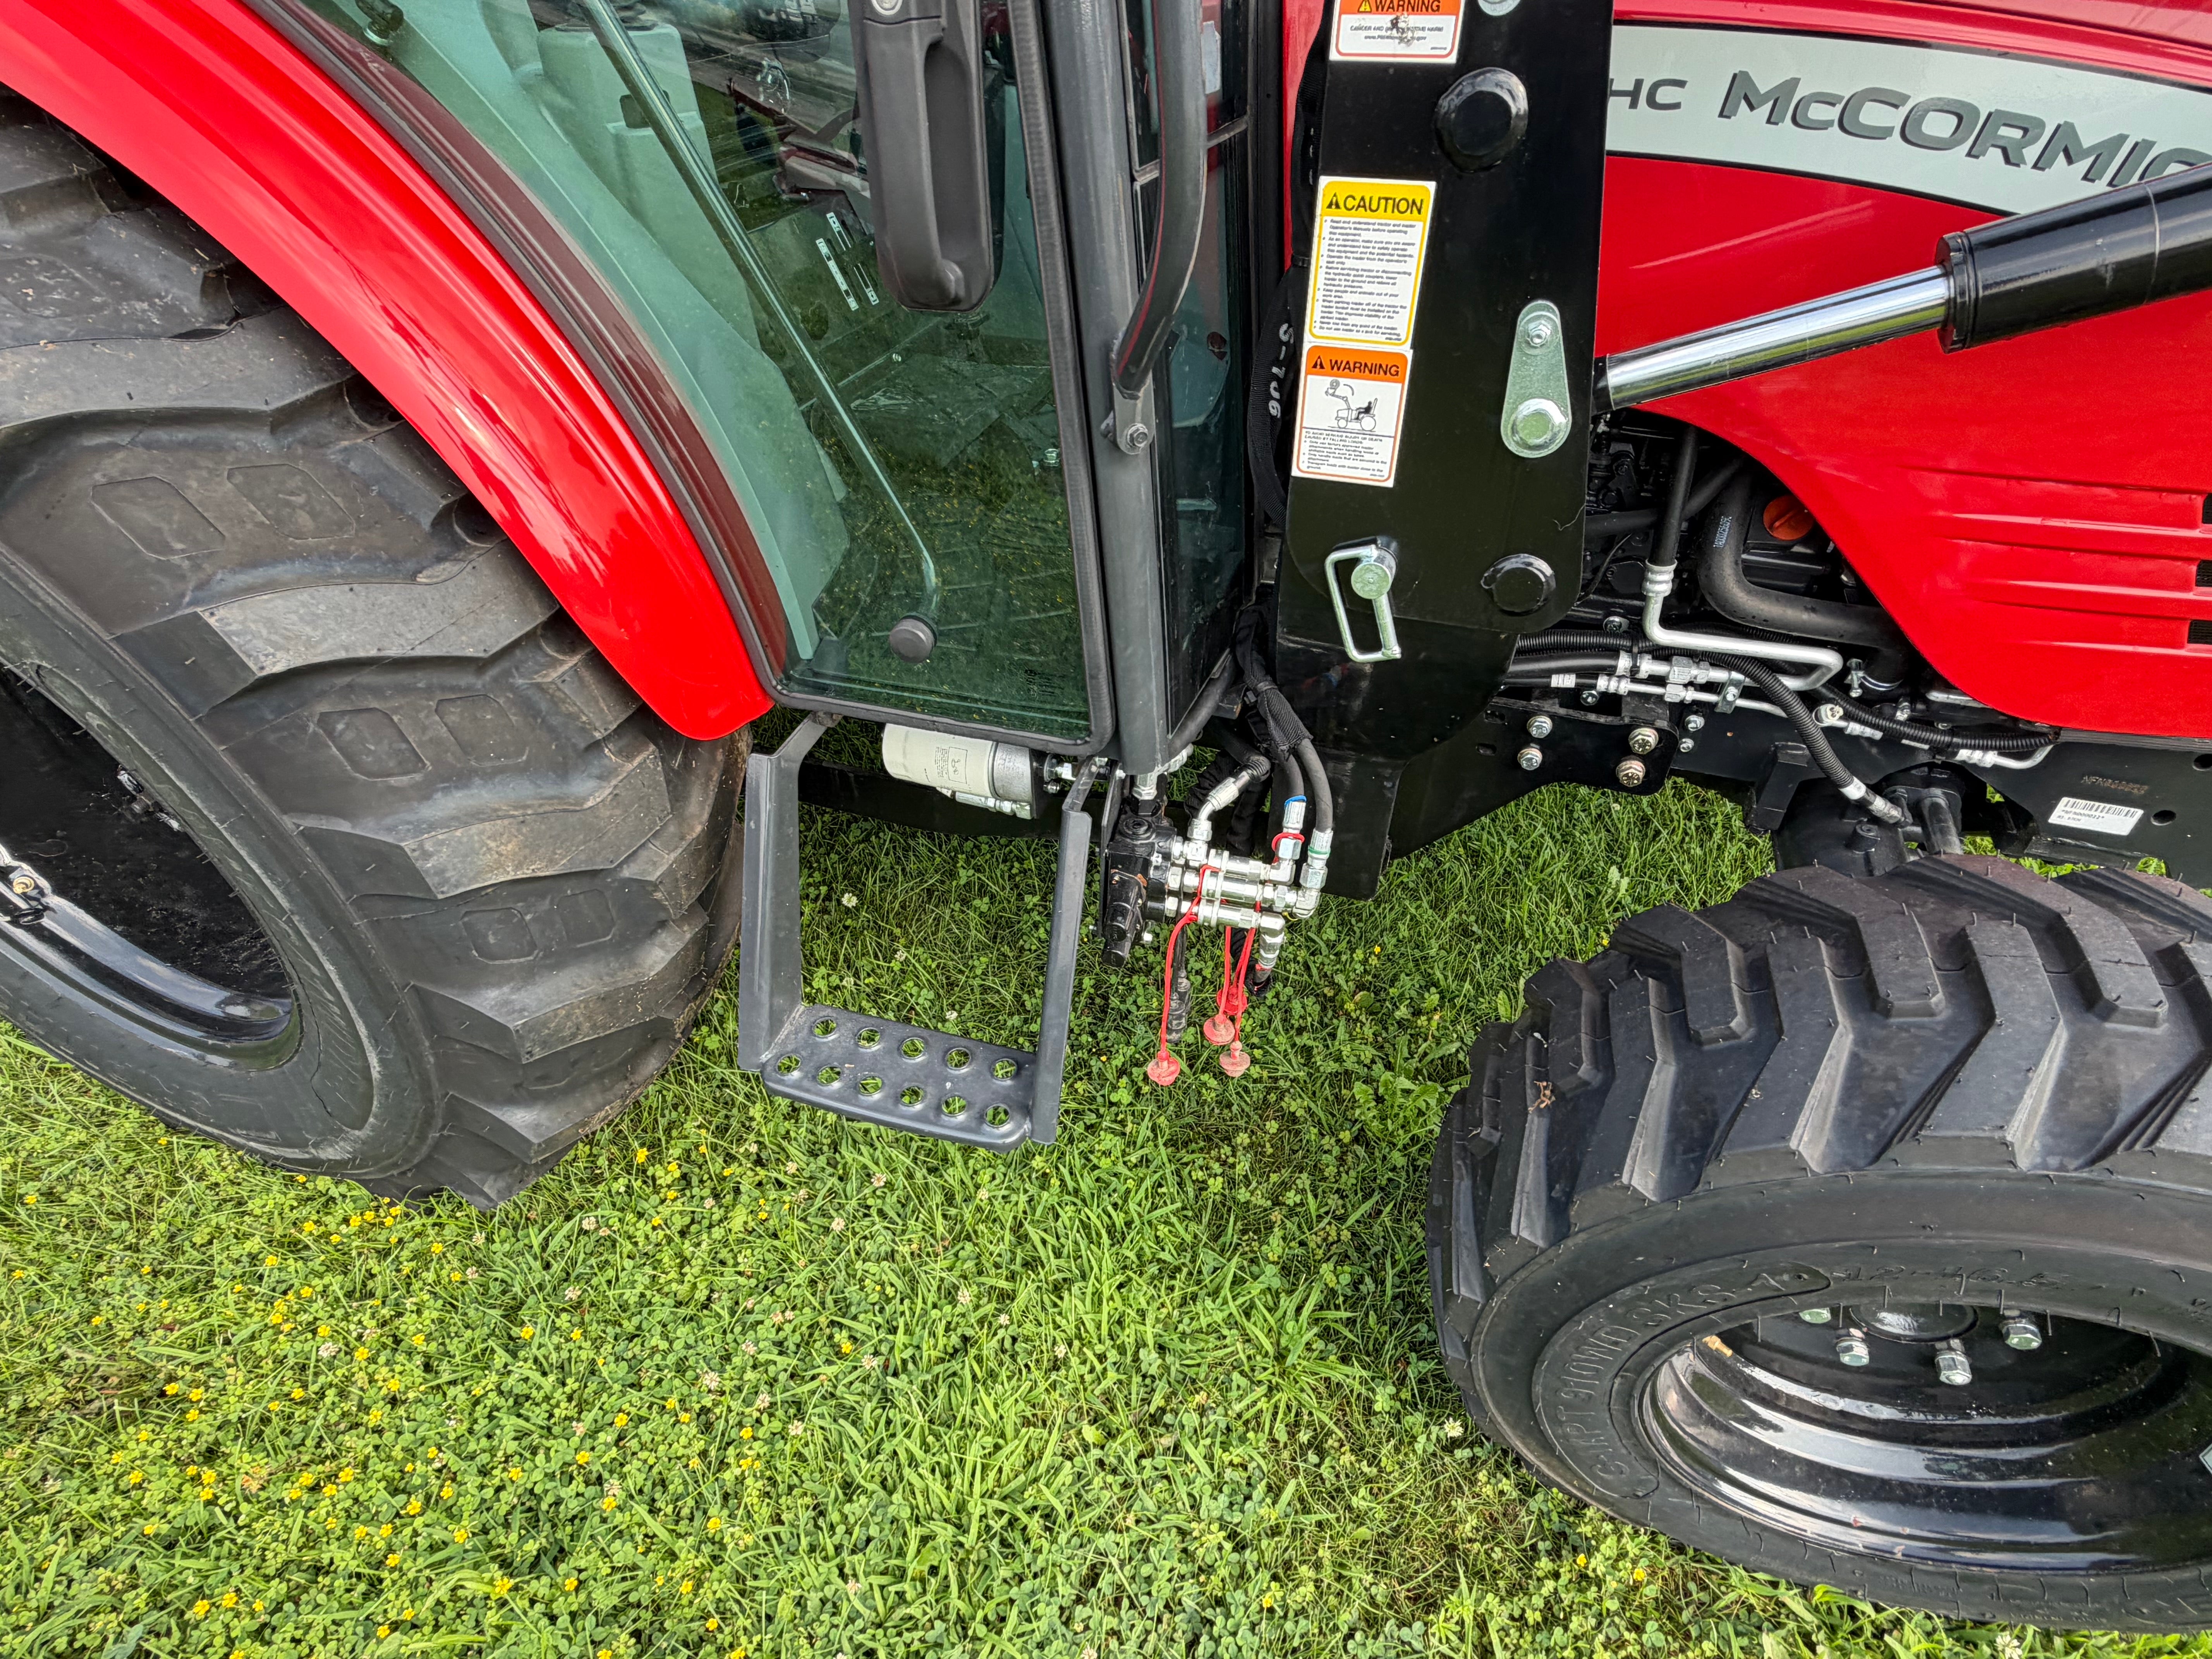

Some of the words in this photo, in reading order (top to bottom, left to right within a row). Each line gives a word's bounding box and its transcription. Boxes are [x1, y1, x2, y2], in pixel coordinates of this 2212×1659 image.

[1376, 0, 1441, 12] WARNING
[1343, 194, 1425, 215] CAUTION
[1329, 359, 1400, 377] WARNING
